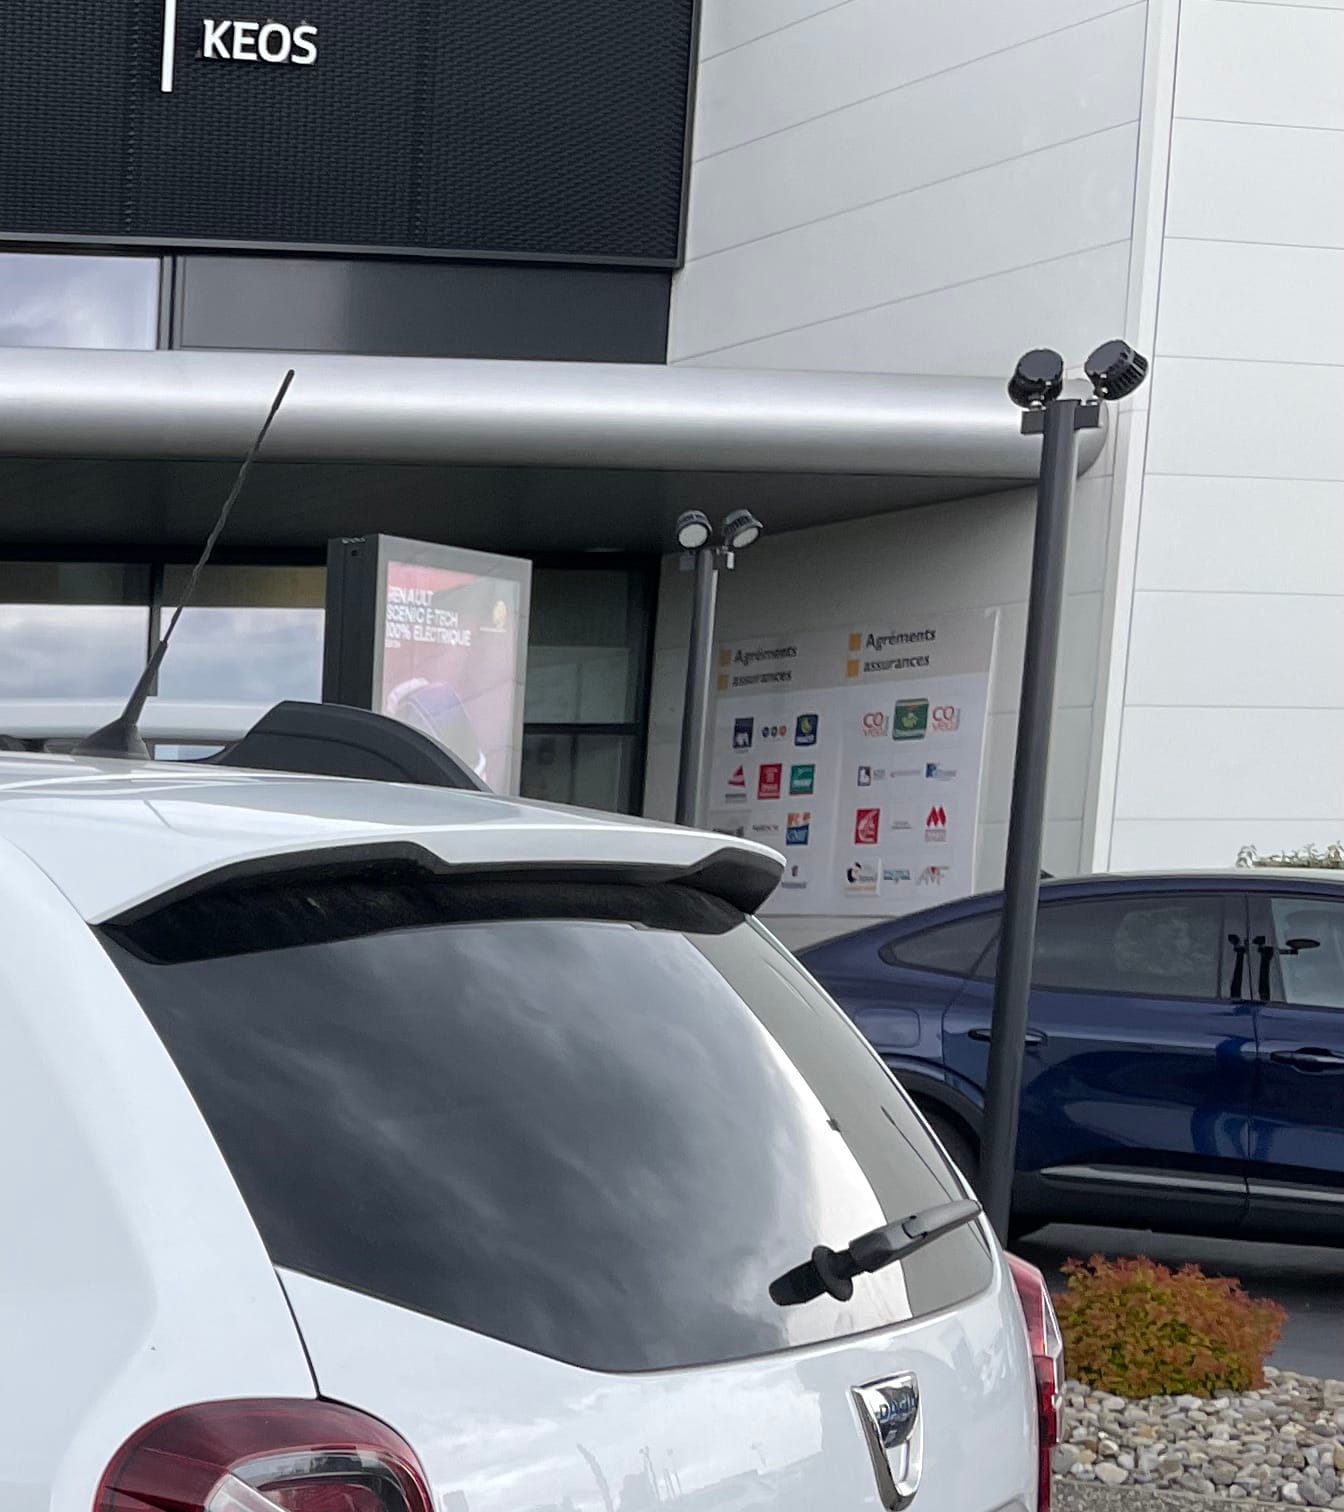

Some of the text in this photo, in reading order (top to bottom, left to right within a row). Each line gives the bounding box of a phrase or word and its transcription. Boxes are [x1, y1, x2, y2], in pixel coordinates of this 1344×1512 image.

[202, 19, 318, 65] KEOS
[388, 586, 434, 606] RENAULT
[386, 603, 458, 628] SCENIC E-TECH
[385, 621, 412, 641] 100%
[866, 628, 936, 651] Agréments
[732, 646, 798, 667] Agréments
[863, 653, 930, 674] assurances
[732, 669, 792, 688] assurances
